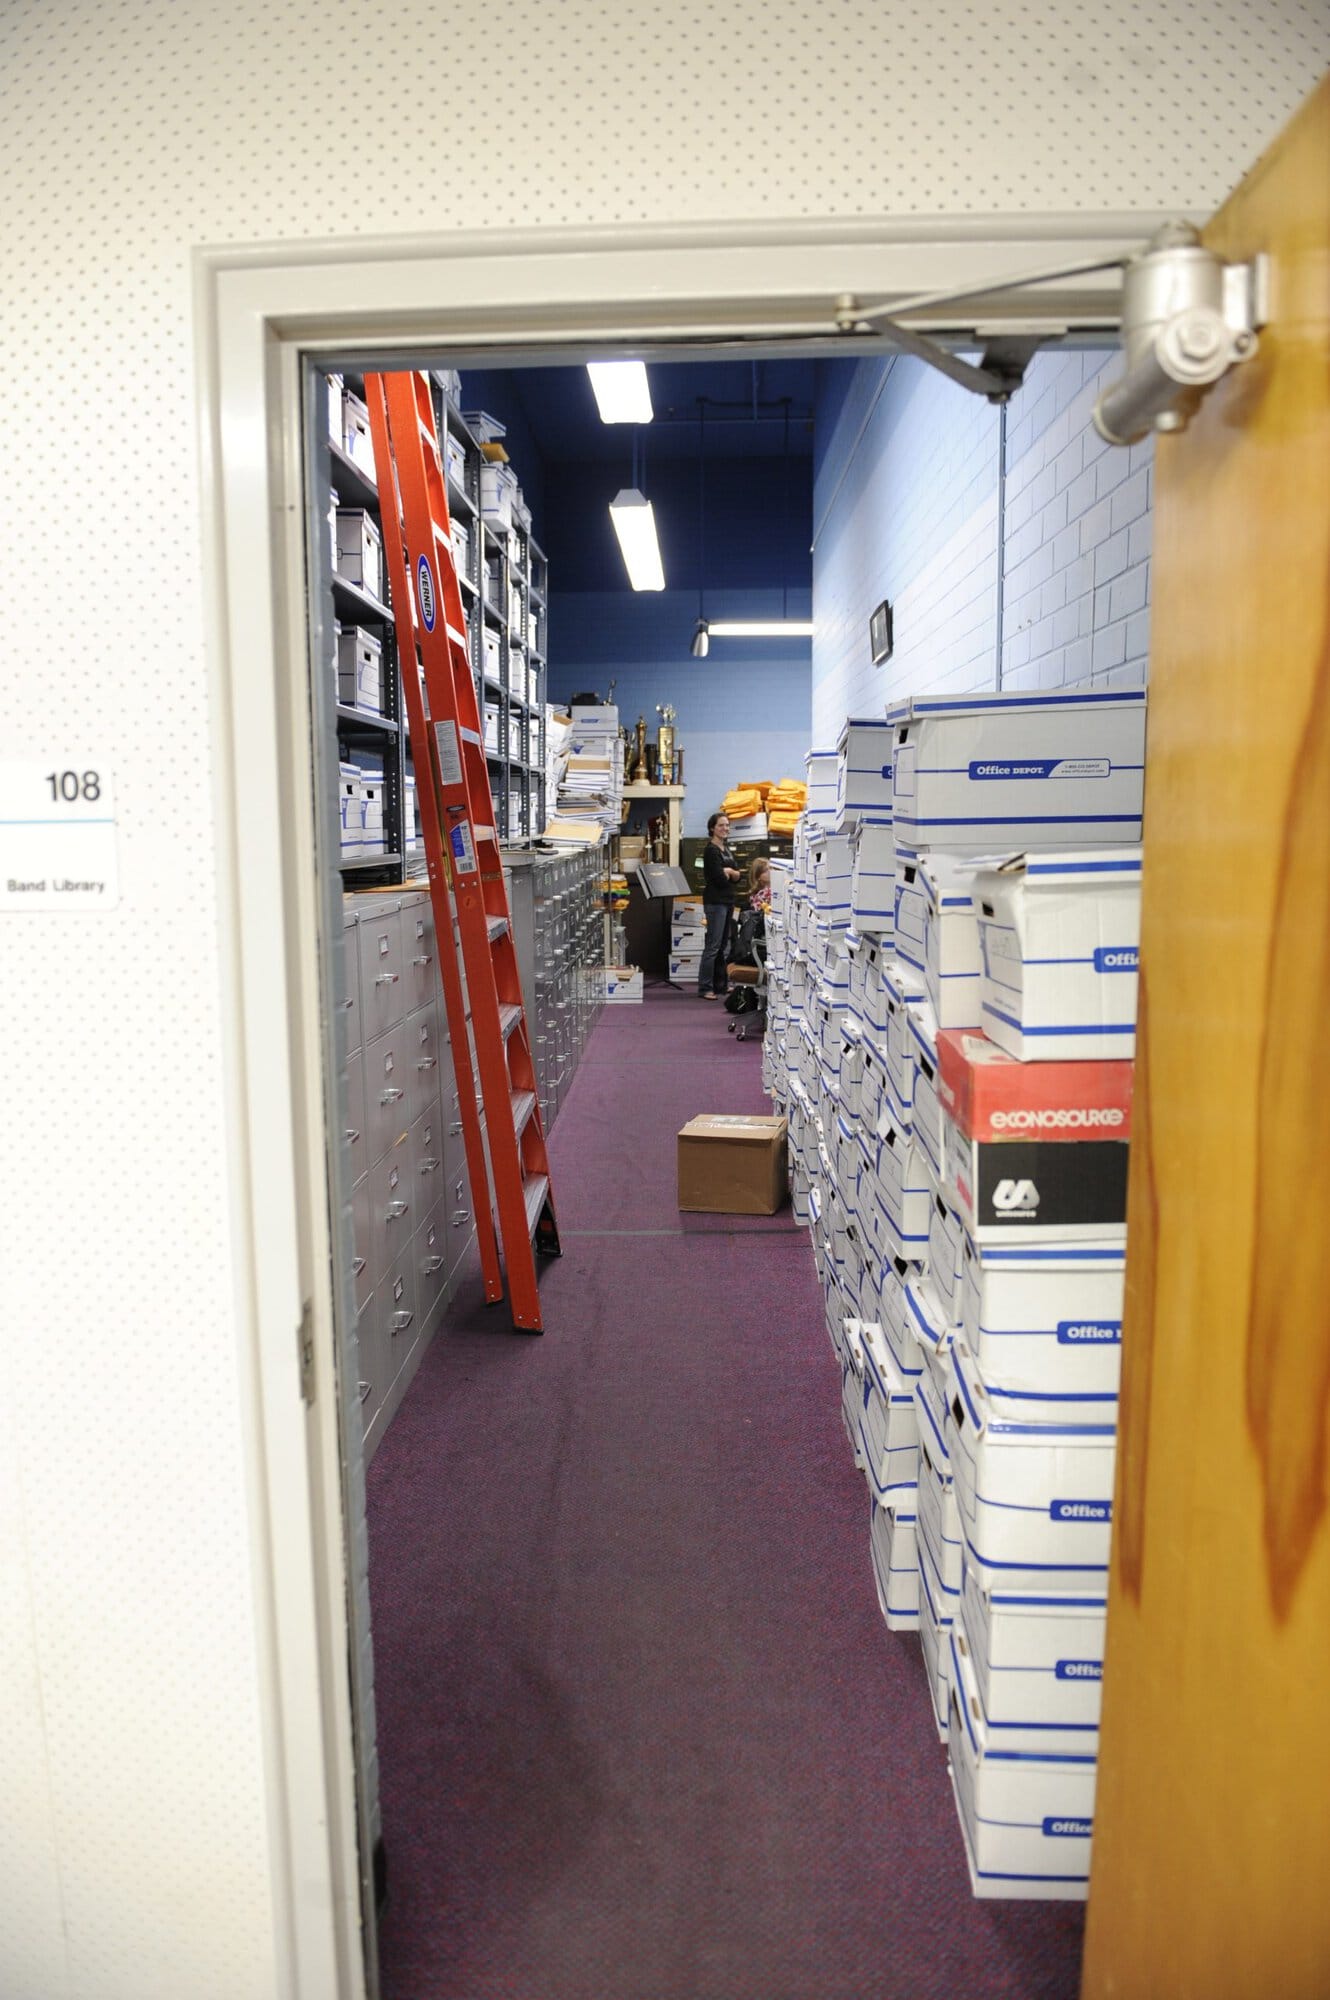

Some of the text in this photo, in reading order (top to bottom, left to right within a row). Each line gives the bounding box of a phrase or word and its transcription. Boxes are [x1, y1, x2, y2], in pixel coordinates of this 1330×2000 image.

[421, 570, 432, 617] WERNER
[976, 765, 1011, 775] Office
[45, 770, 101, 802] 108
[7, 879, 106, 894] Band Library
[1104, 953, 1139, 966] Offi
[1067, 1325, 1114, 1339] Office
[1060, 1504, 1106, 1518] Office
[1064, 1663, 1104, 1677] Offic
